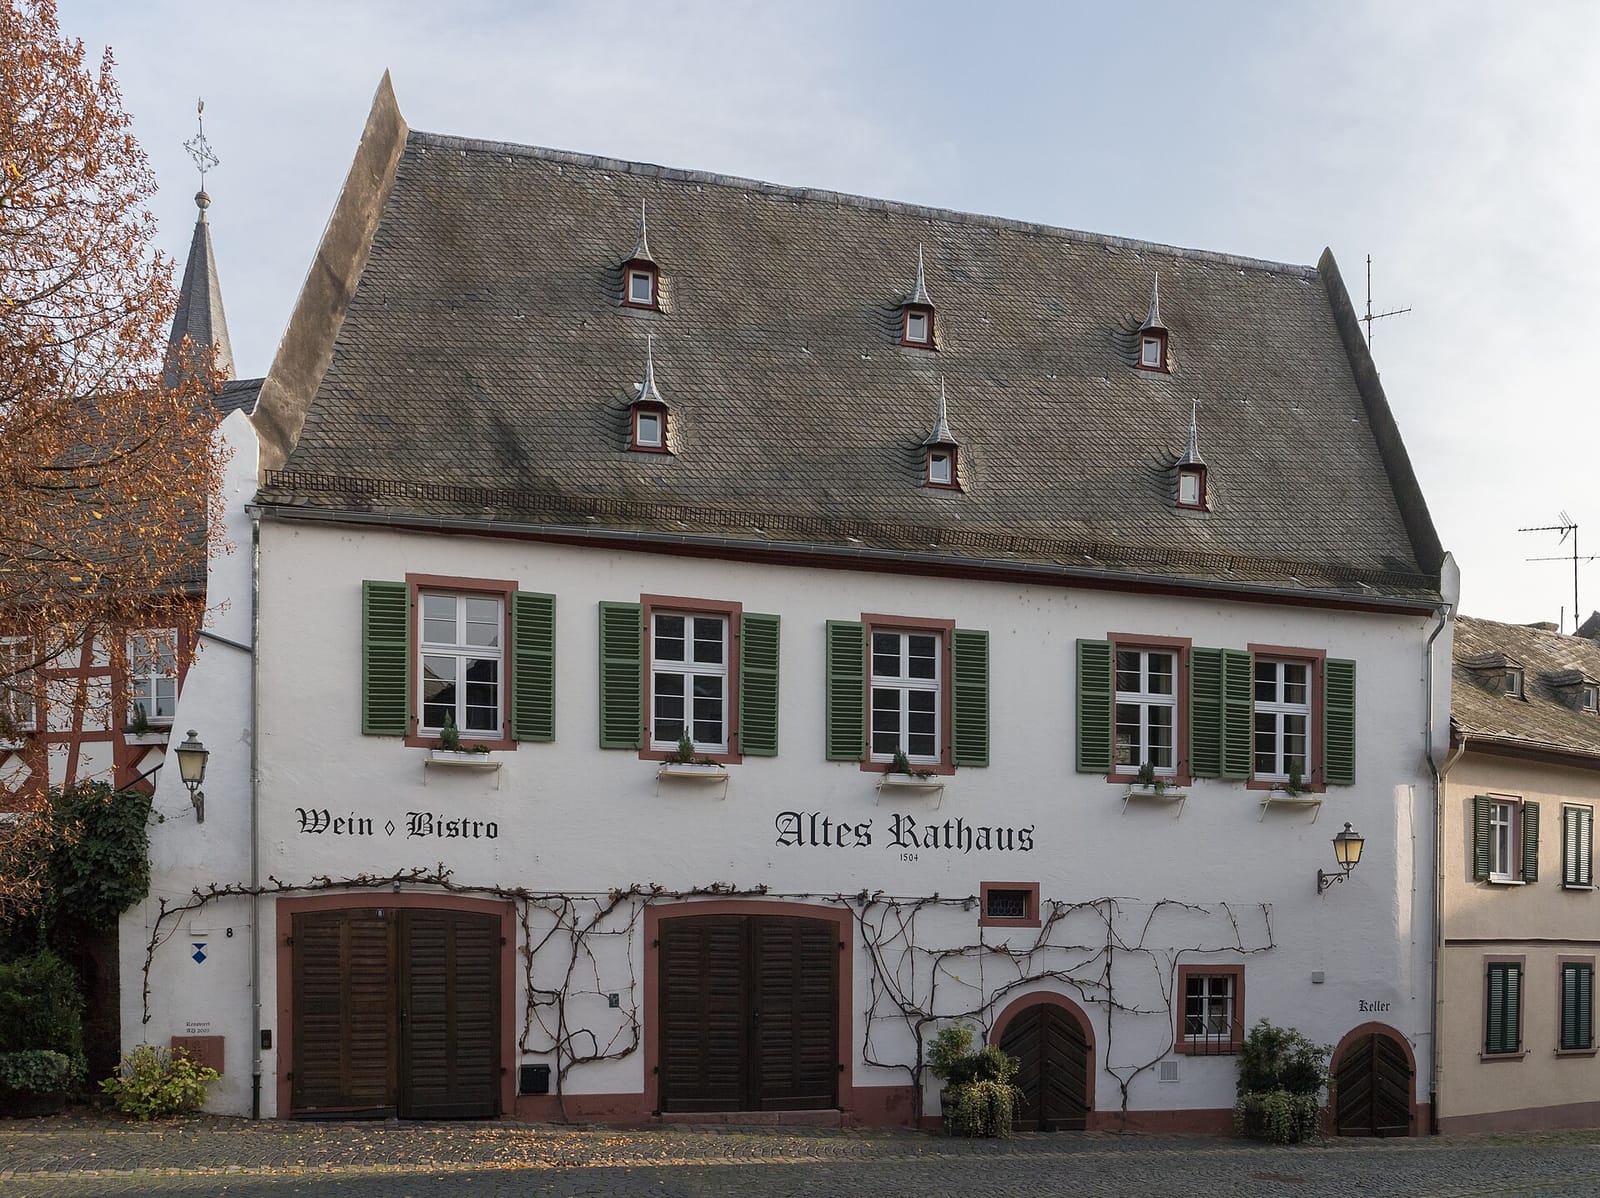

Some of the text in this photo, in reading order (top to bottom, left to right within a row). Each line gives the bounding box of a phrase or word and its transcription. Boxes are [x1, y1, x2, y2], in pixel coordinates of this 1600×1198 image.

[295, 807, 498, 840] Wein Bistro
[775, 811, 1035, 855] Altes Rathaus
[900, 853, 919, 862] 1504
[226, 927, 233, 938] 8
[1359, 999, 1391, 1012] Keller
